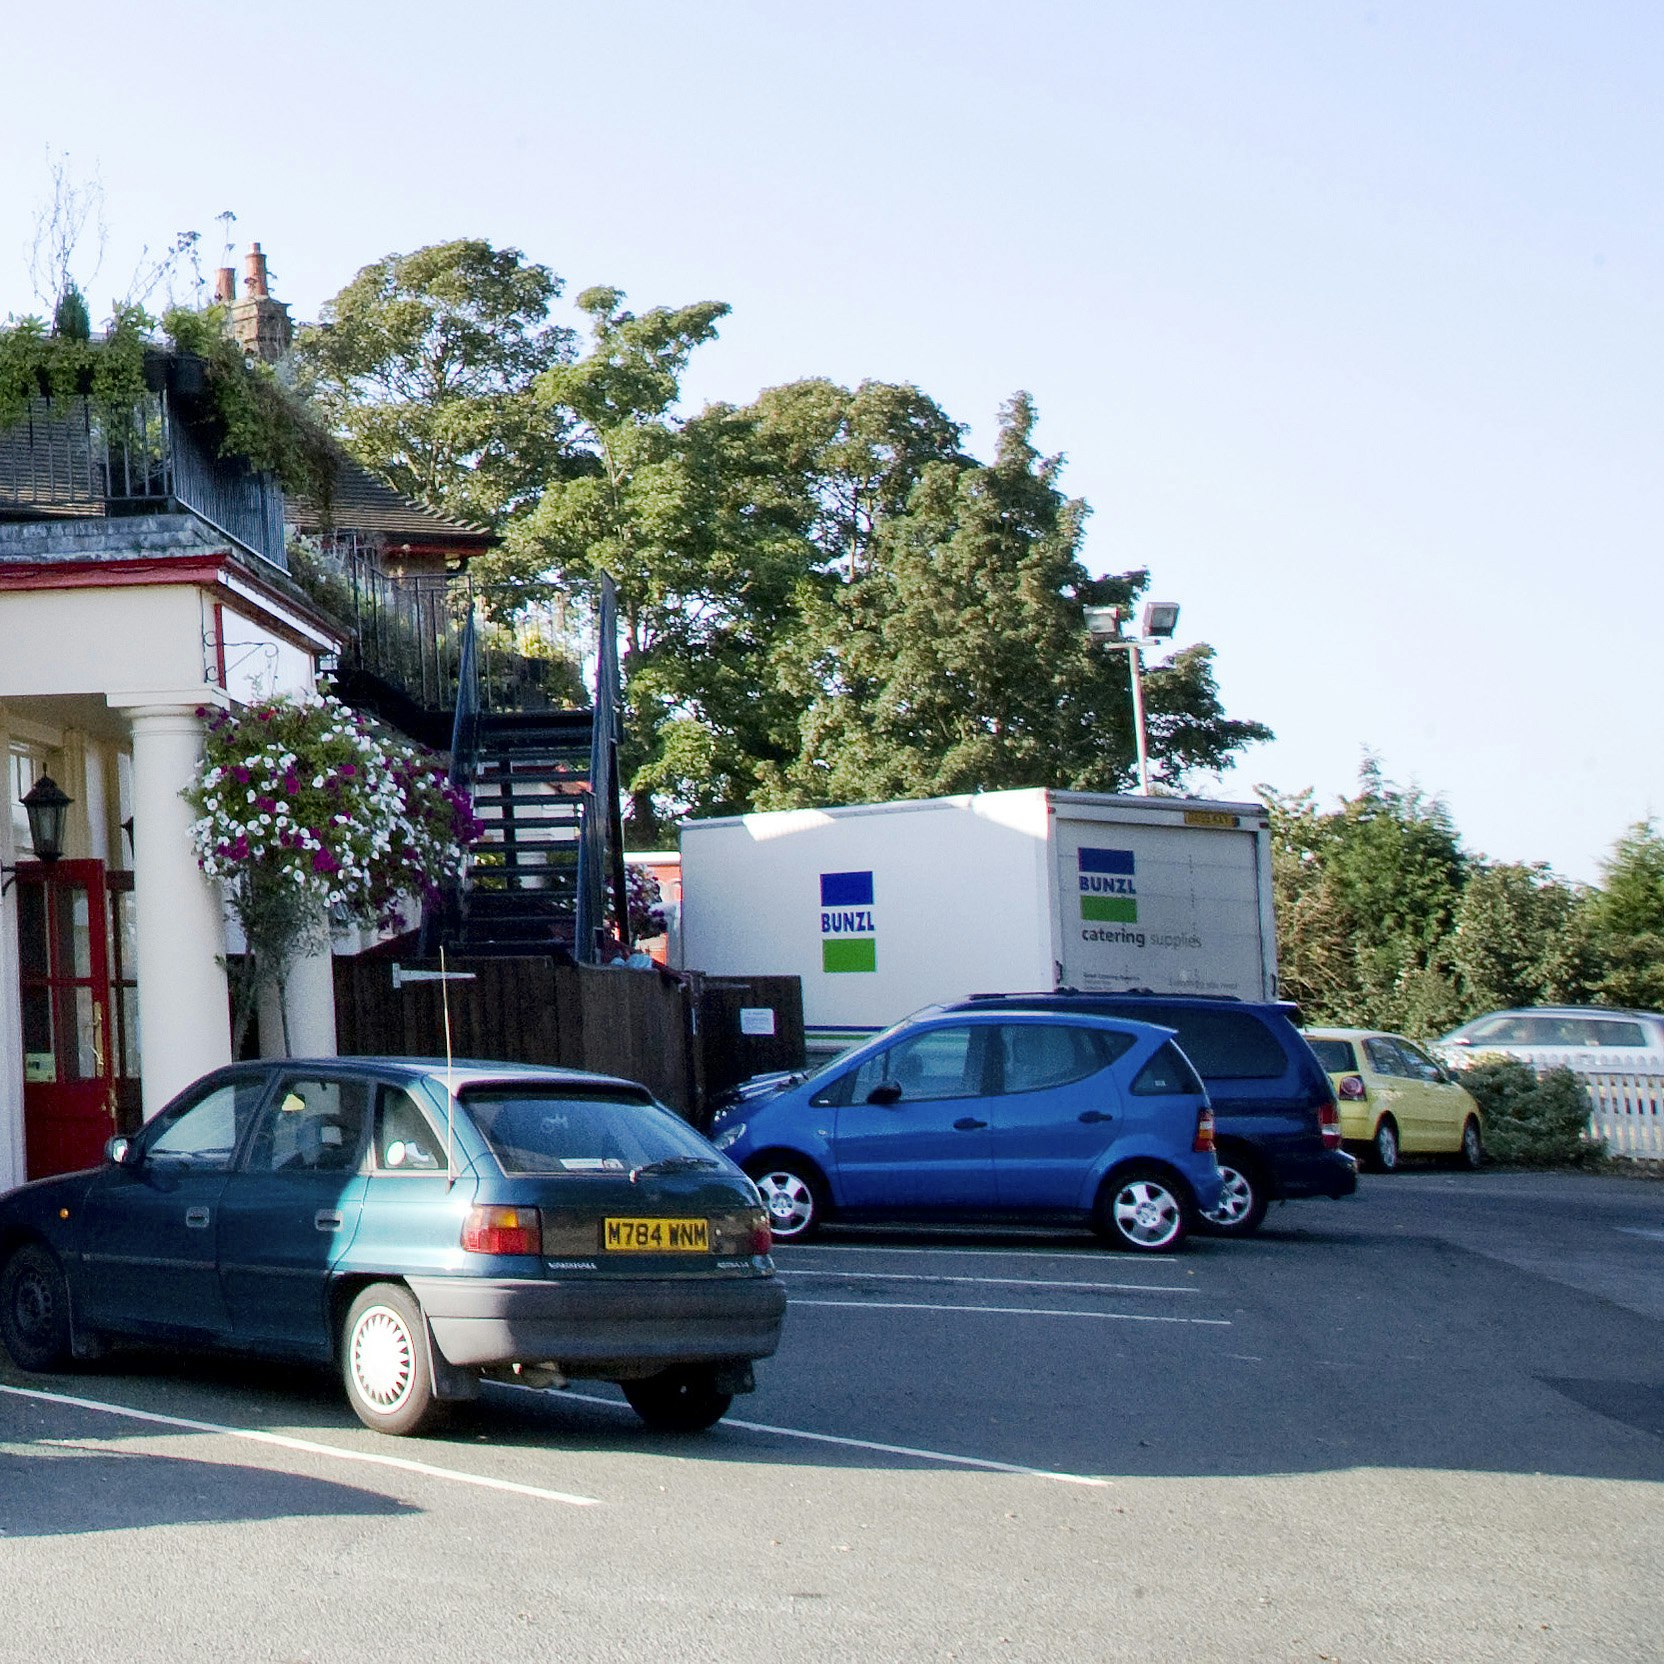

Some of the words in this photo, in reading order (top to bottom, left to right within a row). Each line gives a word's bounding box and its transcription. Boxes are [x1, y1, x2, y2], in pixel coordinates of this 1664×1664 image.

[1078, 876, 1137, 894] BUNZL
[821, 912, 875, 933] BUNZL
[1082, 928, 1146, 947] catering
[1149, 934, 1203, 949] supplies
[607, 1222, 662, 1246] M784
[668, 1223, 708, 1247] WNM
